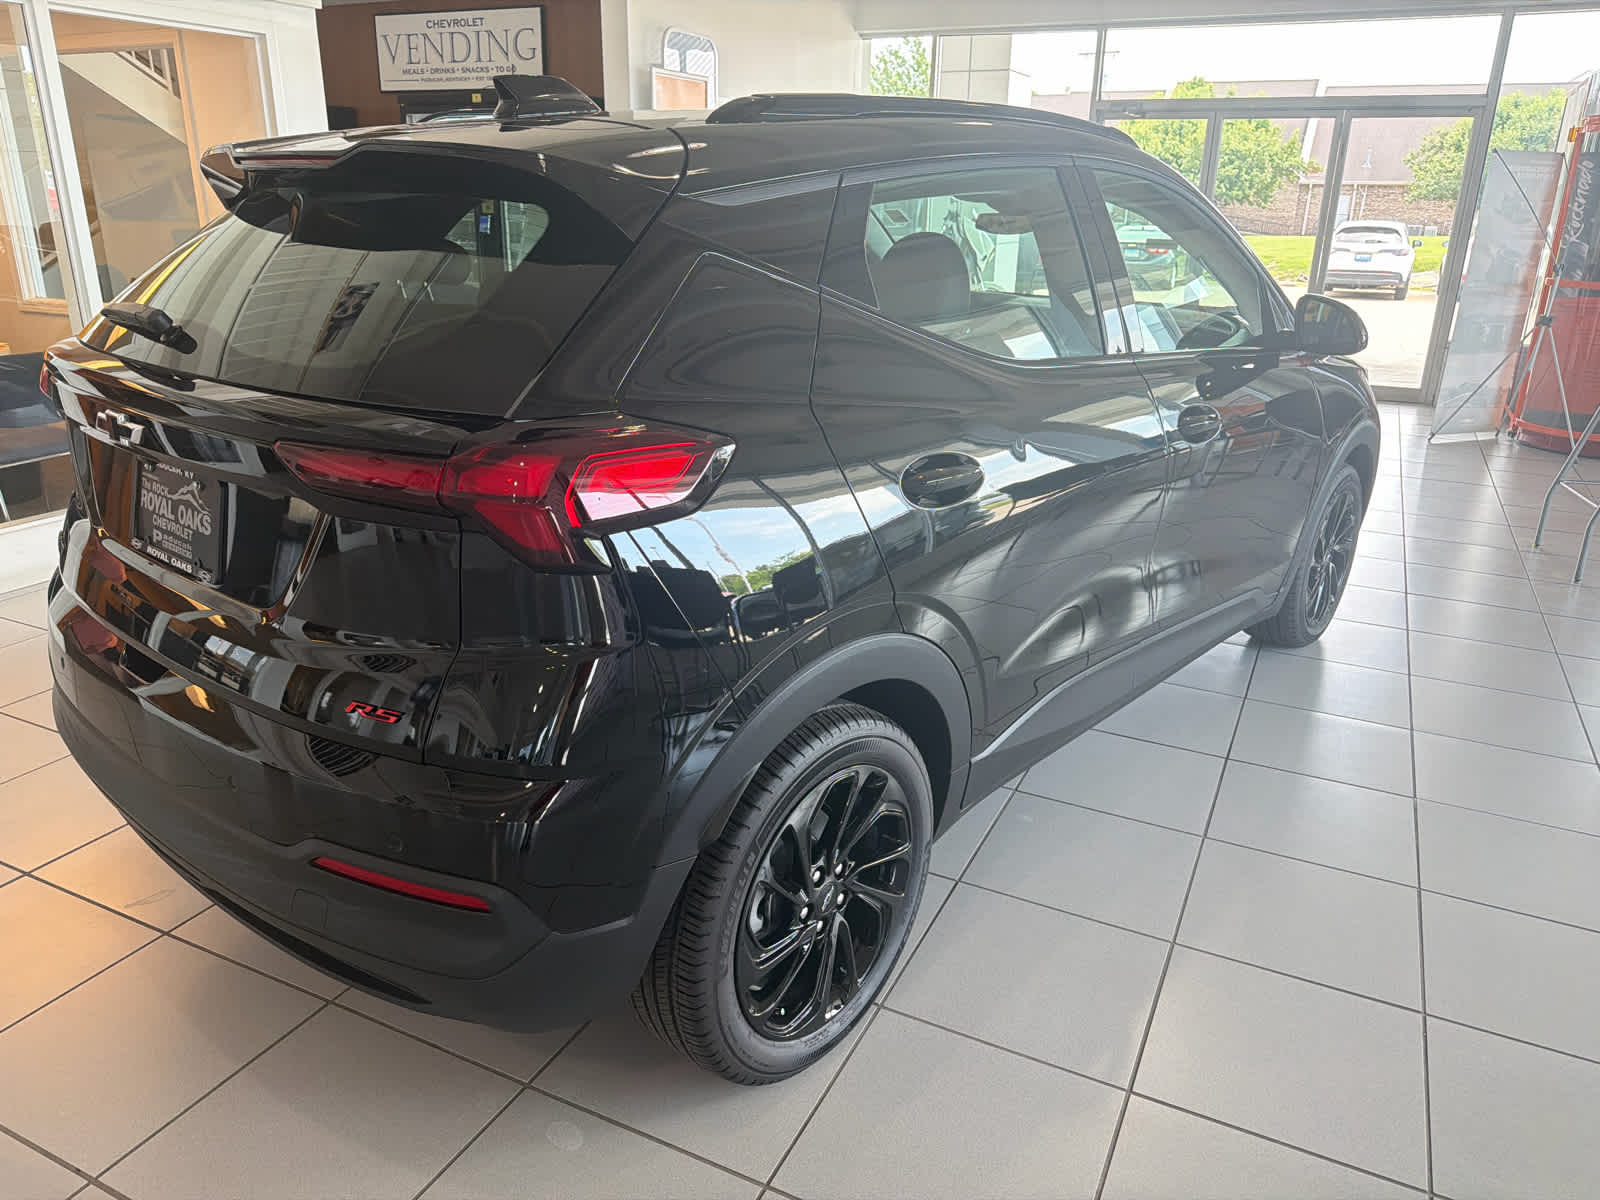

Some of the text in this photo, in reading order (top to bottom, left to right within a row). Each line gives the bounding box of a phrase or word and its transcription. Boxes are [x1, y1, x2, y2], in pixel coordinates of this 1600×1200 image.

[426, 17, 485, 29] CHEVROLET
[381, 27, 537, 65] VENDING
[402, 67, 425, 75] MEALS
[430, 66, 455, 75] DRINKS
[461, 65, 490, 74] SNACKS
[495, 65, 504, 73] TO
[141, 488, 212, 536] ROYAL OAKS
[152, 514, 193, 541] CHEVROLET
[146, 545, 169, 563] ROYAL
[171, 558, 193, 573] OAKS
[344, 701, 405, 724] RS
